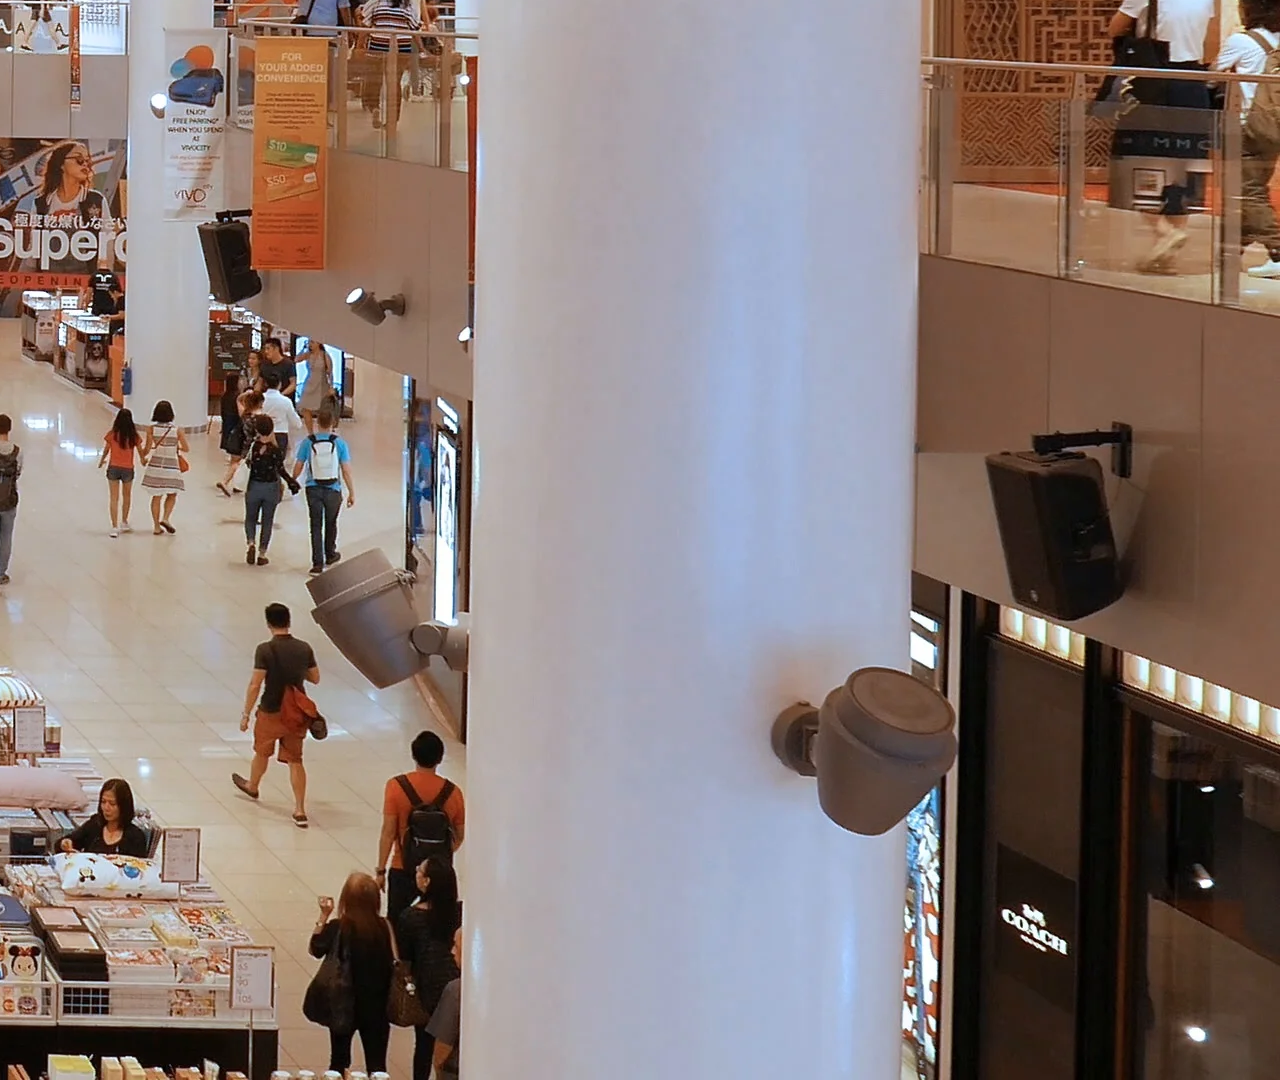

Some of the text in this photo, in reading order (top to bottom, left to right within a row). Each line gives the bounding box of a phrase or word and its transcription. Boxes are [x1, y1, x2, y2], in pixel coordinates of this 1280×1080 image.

[281, 52, 302, 61] FOR
[259, 63, 324, 73] YOUR ADDED
[256, 73, 327, 84] CONVENIENCE
[181, 144, 211, 152] VIVOCITY
[268, 139, 287, 152] $10
[266, 174, 287, 188] $50
[1001, 908, 1068, 955] COACH
